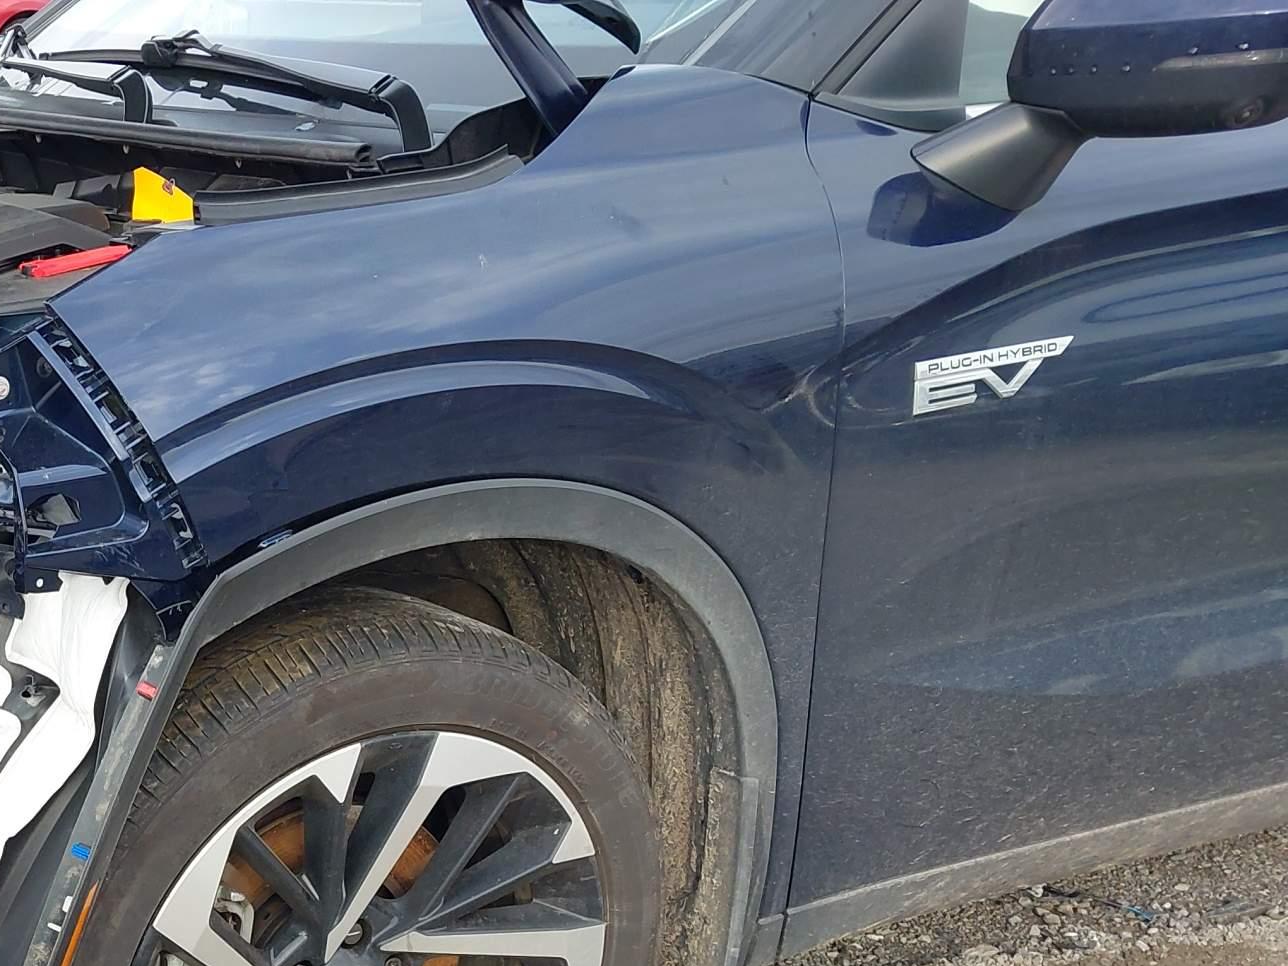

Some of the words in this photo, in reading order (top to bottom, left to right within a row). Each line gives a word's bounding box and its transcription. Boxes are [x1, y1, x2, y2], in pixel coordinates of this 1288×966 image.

[928, 351, 994, 374] PLUG-IN
[998, 342, 1058, 361] HYBRID
[913, 357, 1045, 416] EV
